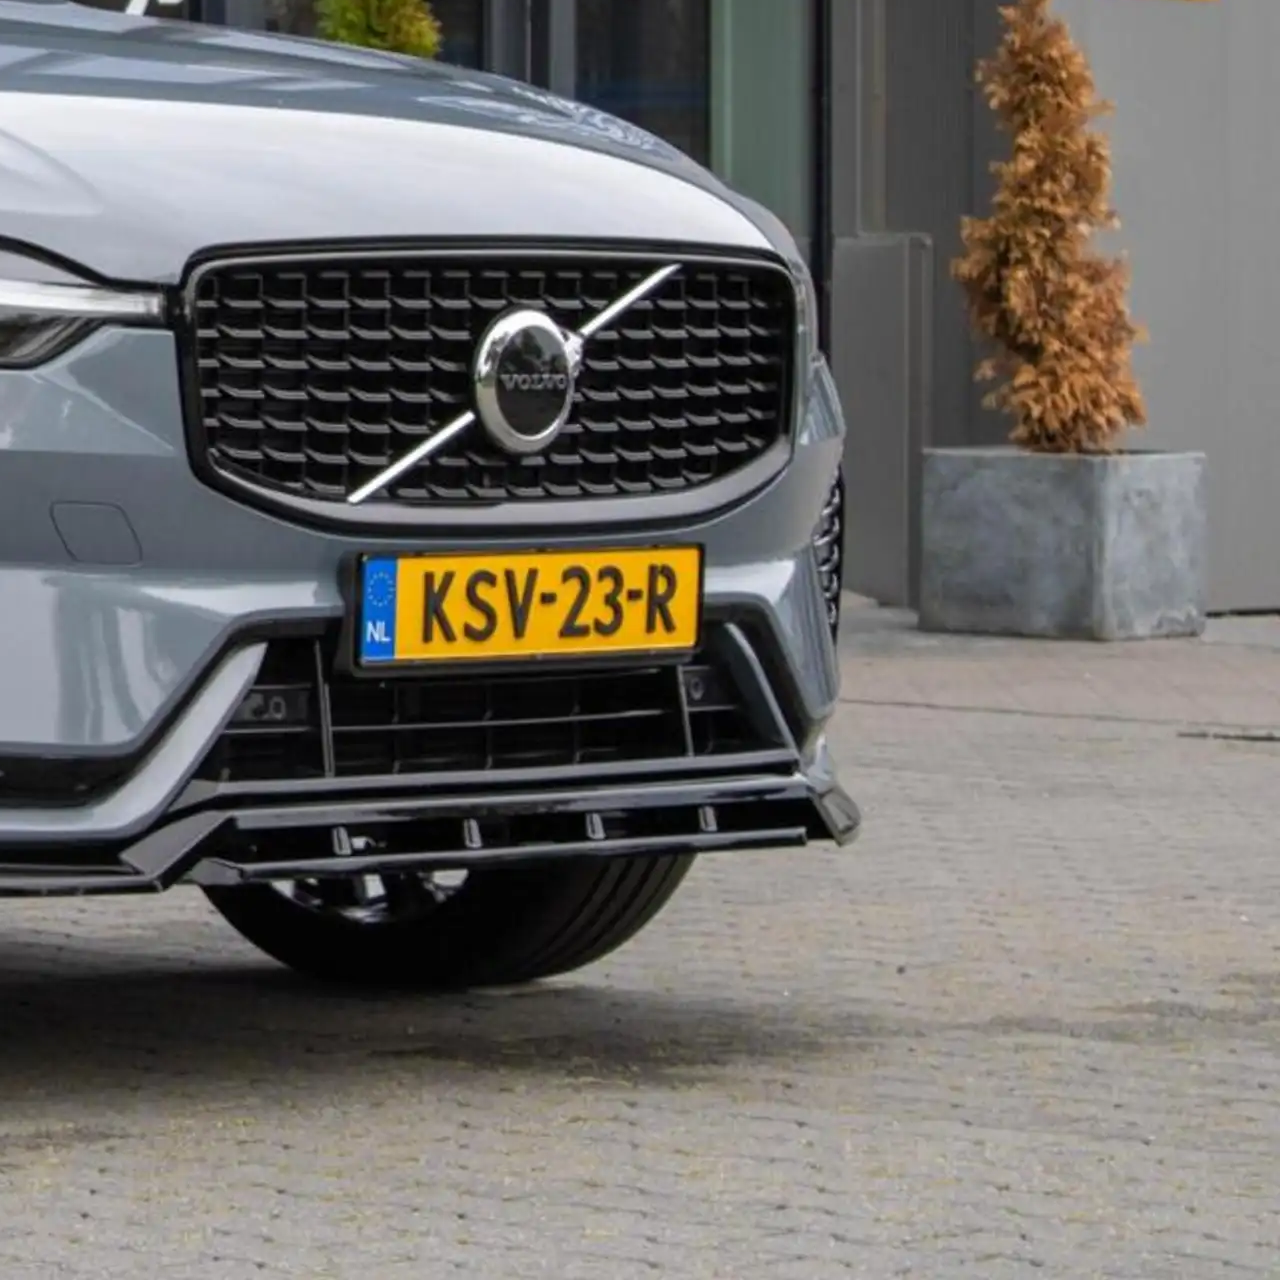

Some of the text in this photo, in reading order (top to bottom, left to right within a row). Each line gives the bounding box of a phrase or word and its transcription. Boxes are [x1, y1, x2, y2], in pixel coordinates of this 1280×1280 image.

[500, 373, 568, 391] VOLVO
[422, 564, 677, 644] KSV-23-R
[365, 622, 391, 644] NL
